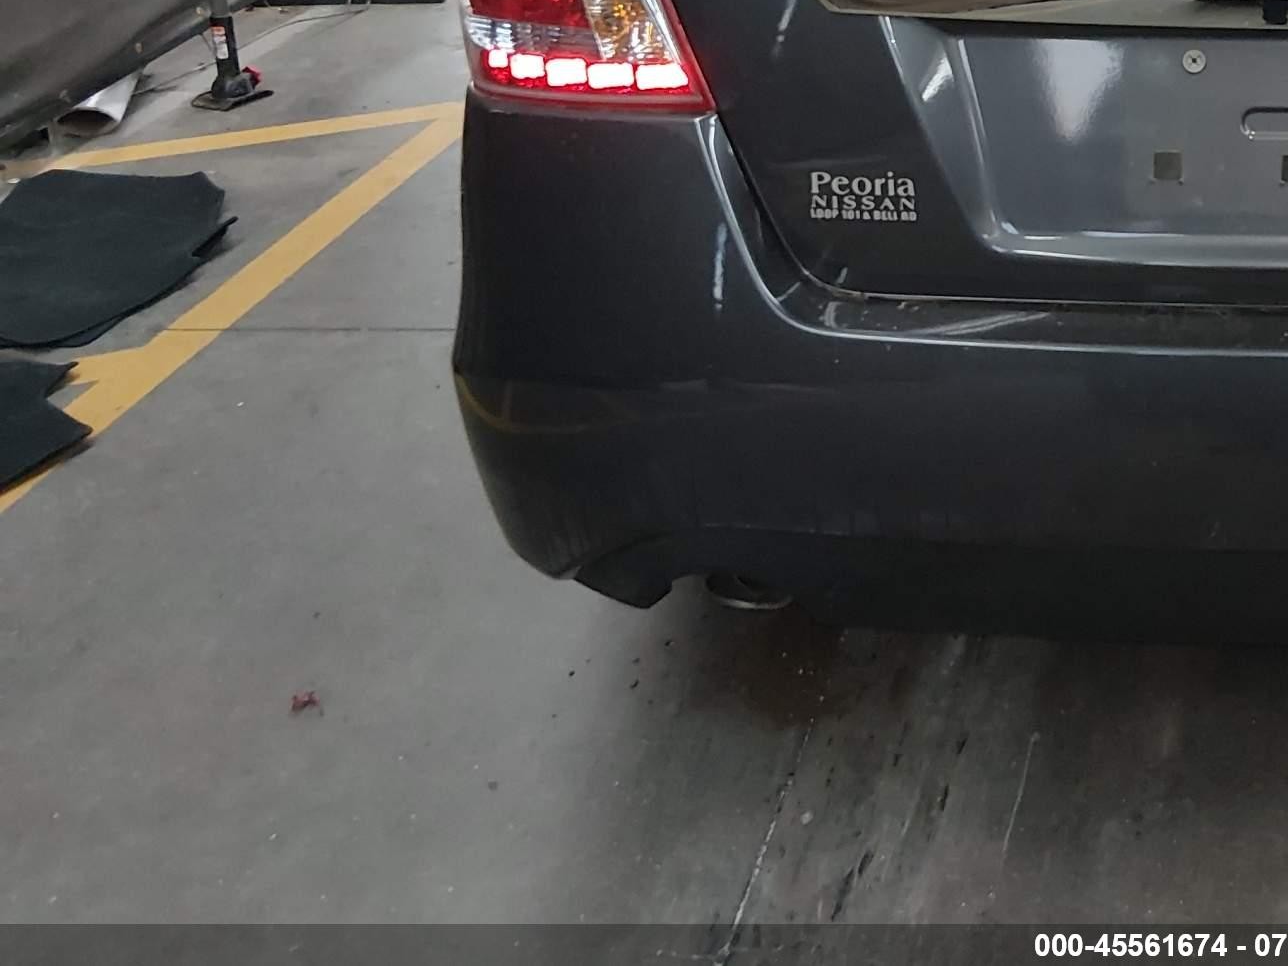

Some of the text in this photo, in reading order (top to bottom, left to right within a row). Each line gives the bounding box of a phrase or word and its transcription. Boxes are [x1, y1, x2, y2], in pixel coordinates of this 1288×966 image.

[810, 171, 915, 196] Peoria
[811, 194, 915, 211] NISSAN
[810, 209, 839, 219] LOOP
[873, 210, 898, 221] BELL
